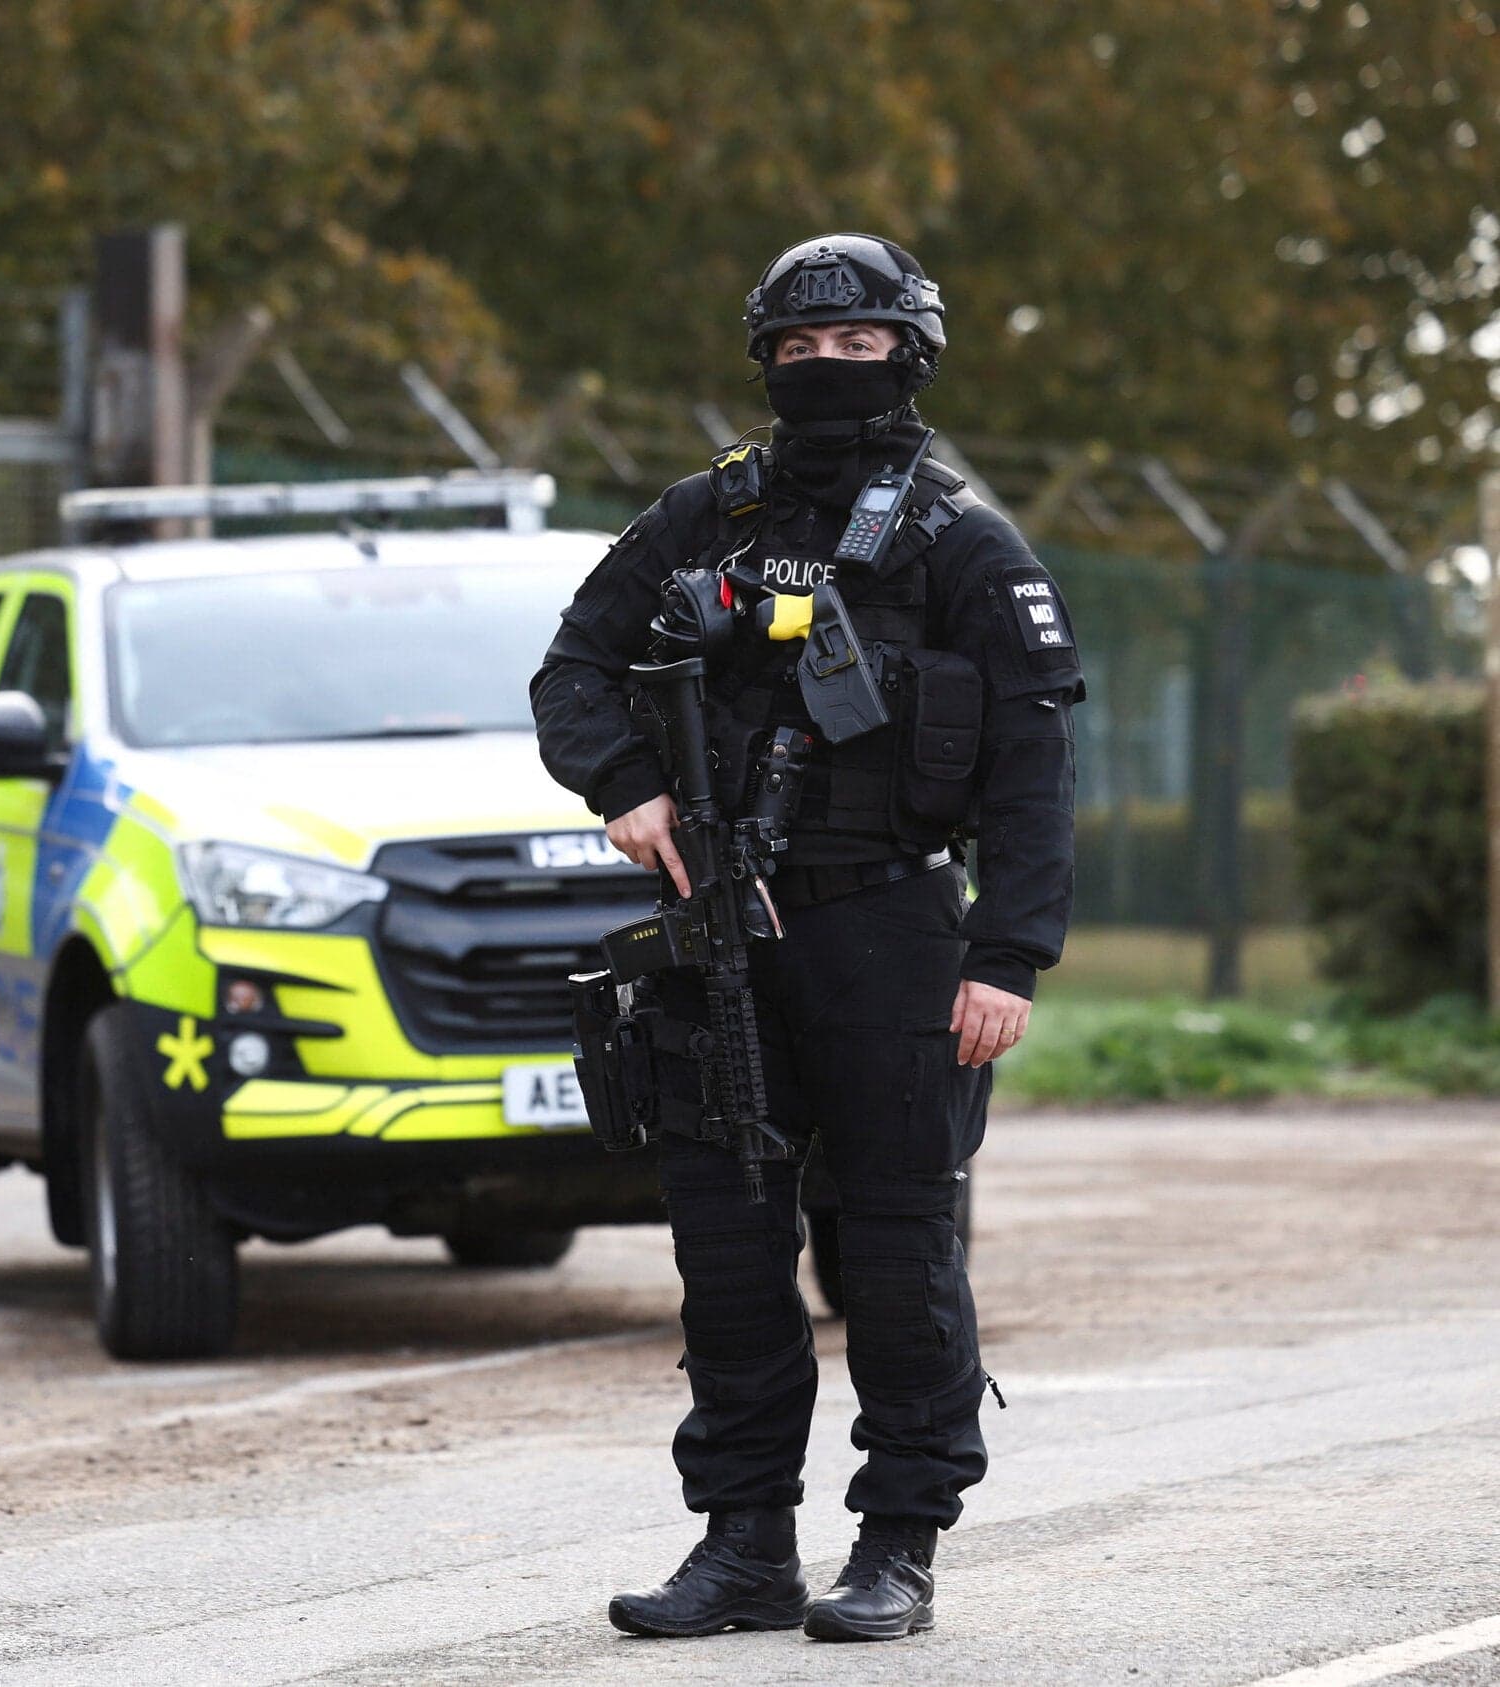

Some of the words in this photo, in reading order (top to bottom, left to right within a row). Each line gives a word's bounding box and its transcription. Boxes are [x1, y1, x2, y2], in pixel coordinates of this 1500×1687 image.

[763, 559, 836, 588] POLICE
[1012, 583, 1052, 599] POLICE
[1028, 604, 1055, 625] MD
[529, 833, 631, 868] ISU
[527, 1072, 579, 1113] AE
